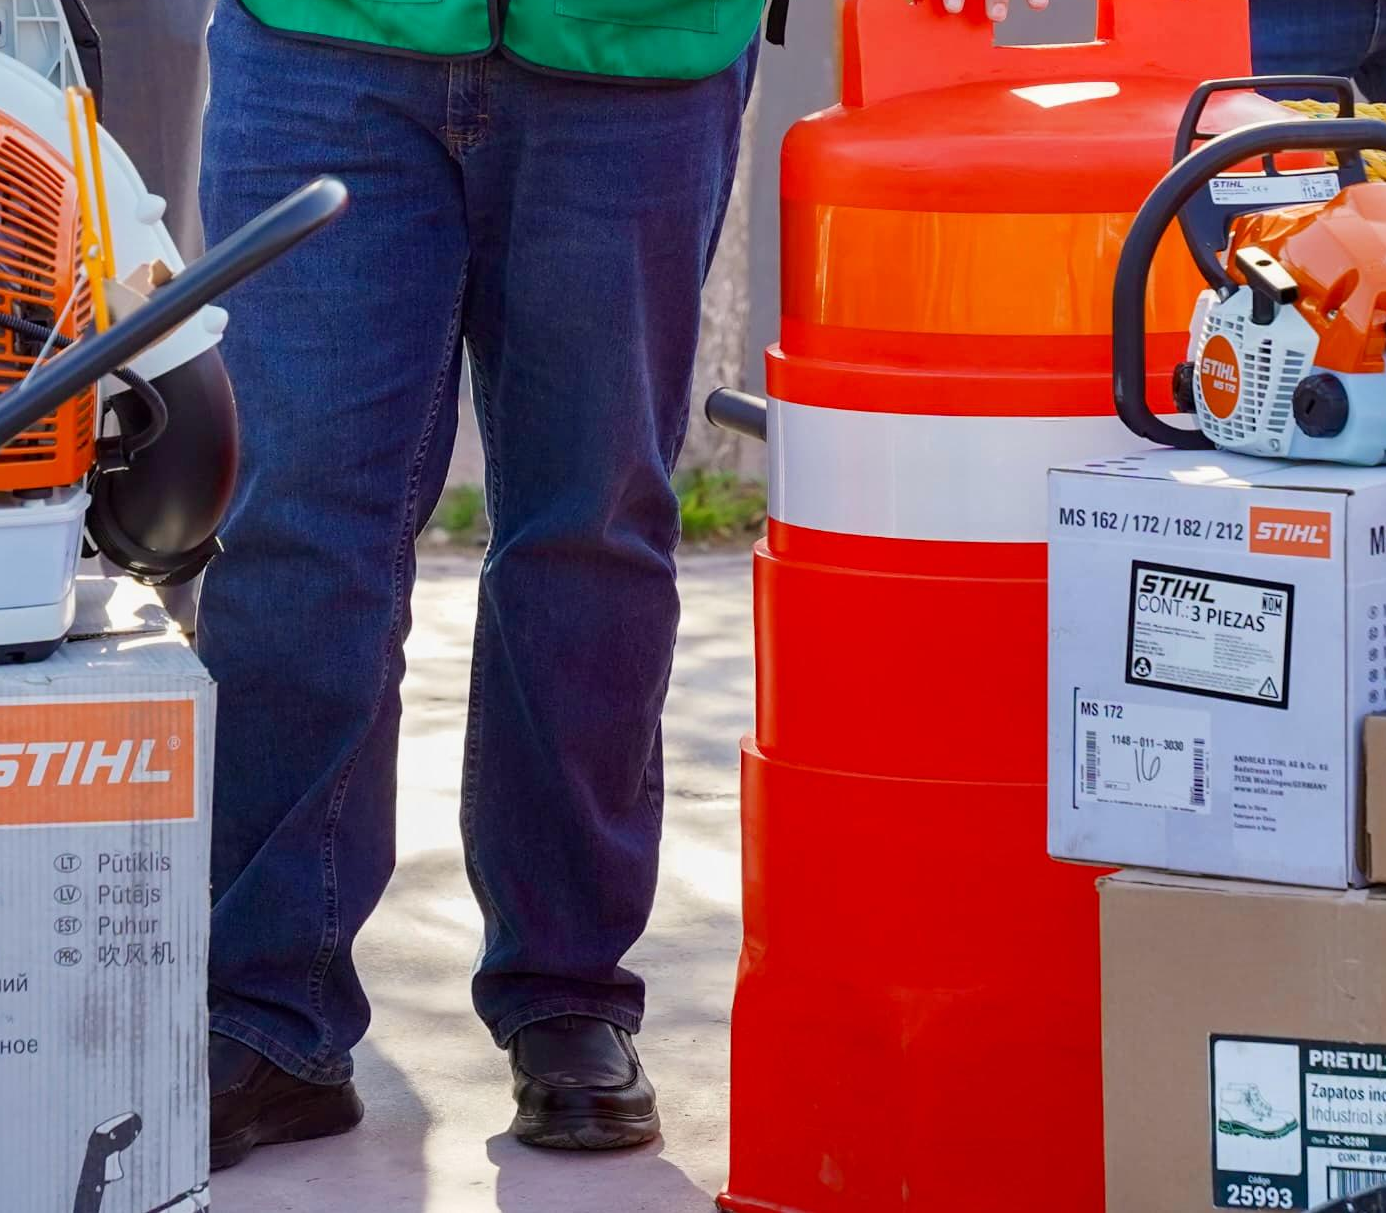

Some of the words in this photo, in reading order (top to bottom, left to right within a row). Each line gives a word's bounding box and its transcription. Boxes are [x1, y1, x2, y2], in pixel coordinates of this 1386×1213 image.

[1202, 357, 1238, 382] STIHL
[1059, 507, 1086, 527] MS
[1091, 511, 1118, 530] 162
[1121, 513, 1129, 533] /
[1132, 514, 1159, 534] 172
[1163, 517, 1171, 536] /
[1174, 518, 1202, 538] 182
[1204, 520, 1212, 540] /
[1215, 521, 1244, 541] 212
[1254, 521, 1324, 544] STIHL
[1140, 574, 1216, 603] STIHL
[1261, 592, 1283, 616] NOM
[1206, 608, 1265, 632] PIEZAS
[1080, 702, 1098, 716] MS
[1103, 704, 1123, 719] 172
[60, 856, 76, 871] LT
[98, 851, 171, 874] Pūtiklis
[60, 888, 77, 902] LV
[98, 884, 161, 908] Pūtējs
[58, 918, 78, 933] EST
[98, 916, 159, 936] Puhur
[98, 941, 175, 968] 吹风机
[1311, 1082, 1365, 1102] Zapatos
[1311, 1105, 1372, 1125] Industrial
[1227, 1185, 1293, 1210] 25993
